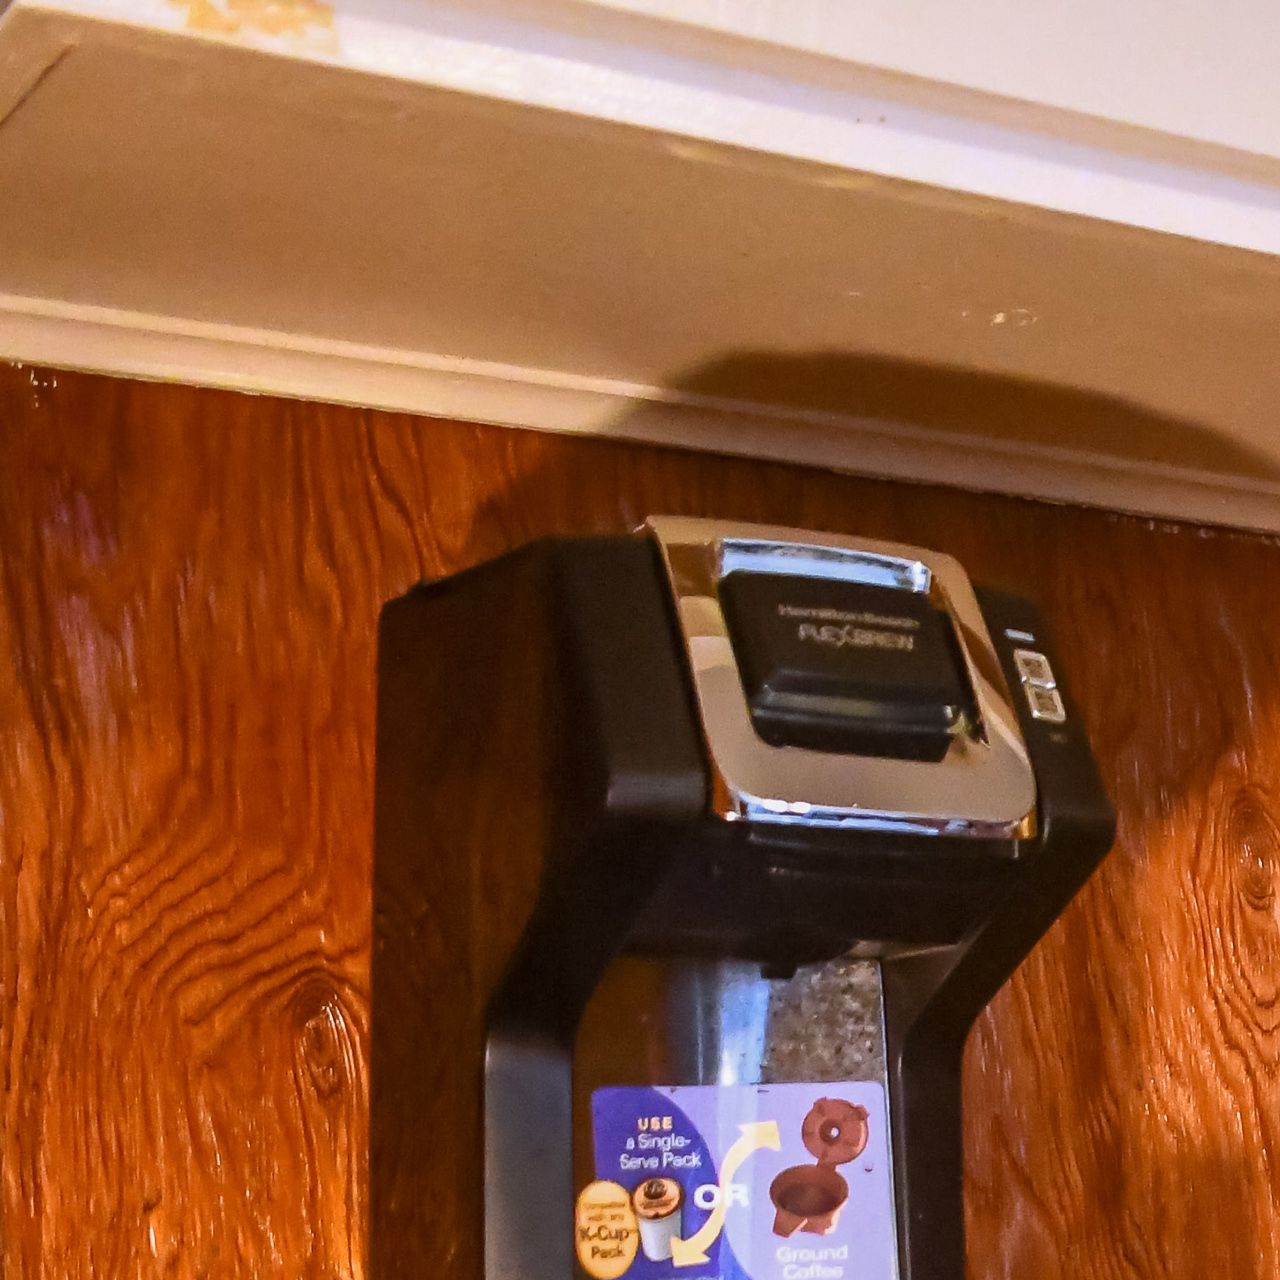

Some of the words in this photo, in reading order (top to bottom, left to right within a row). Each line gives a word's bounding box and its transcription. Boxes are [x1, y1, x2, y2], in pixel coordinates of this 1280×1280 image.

[637, 1116, 674, 1131] USE
[626, 1137, 635, 1149] a
[638, 1133, 691, 1151] Single-
[620, 1153, 659, 1170] Serve
[662, 1151, 702, 1168] Pack
[693, 1183, 749, 1210] OR
[579, 1224, 630, 1242] K-Cup
[591, 1243, 625, 1259] Pack
[777, 1244, 848, 1262] Ground
[783, 1264, 844, 1280] Coffee
